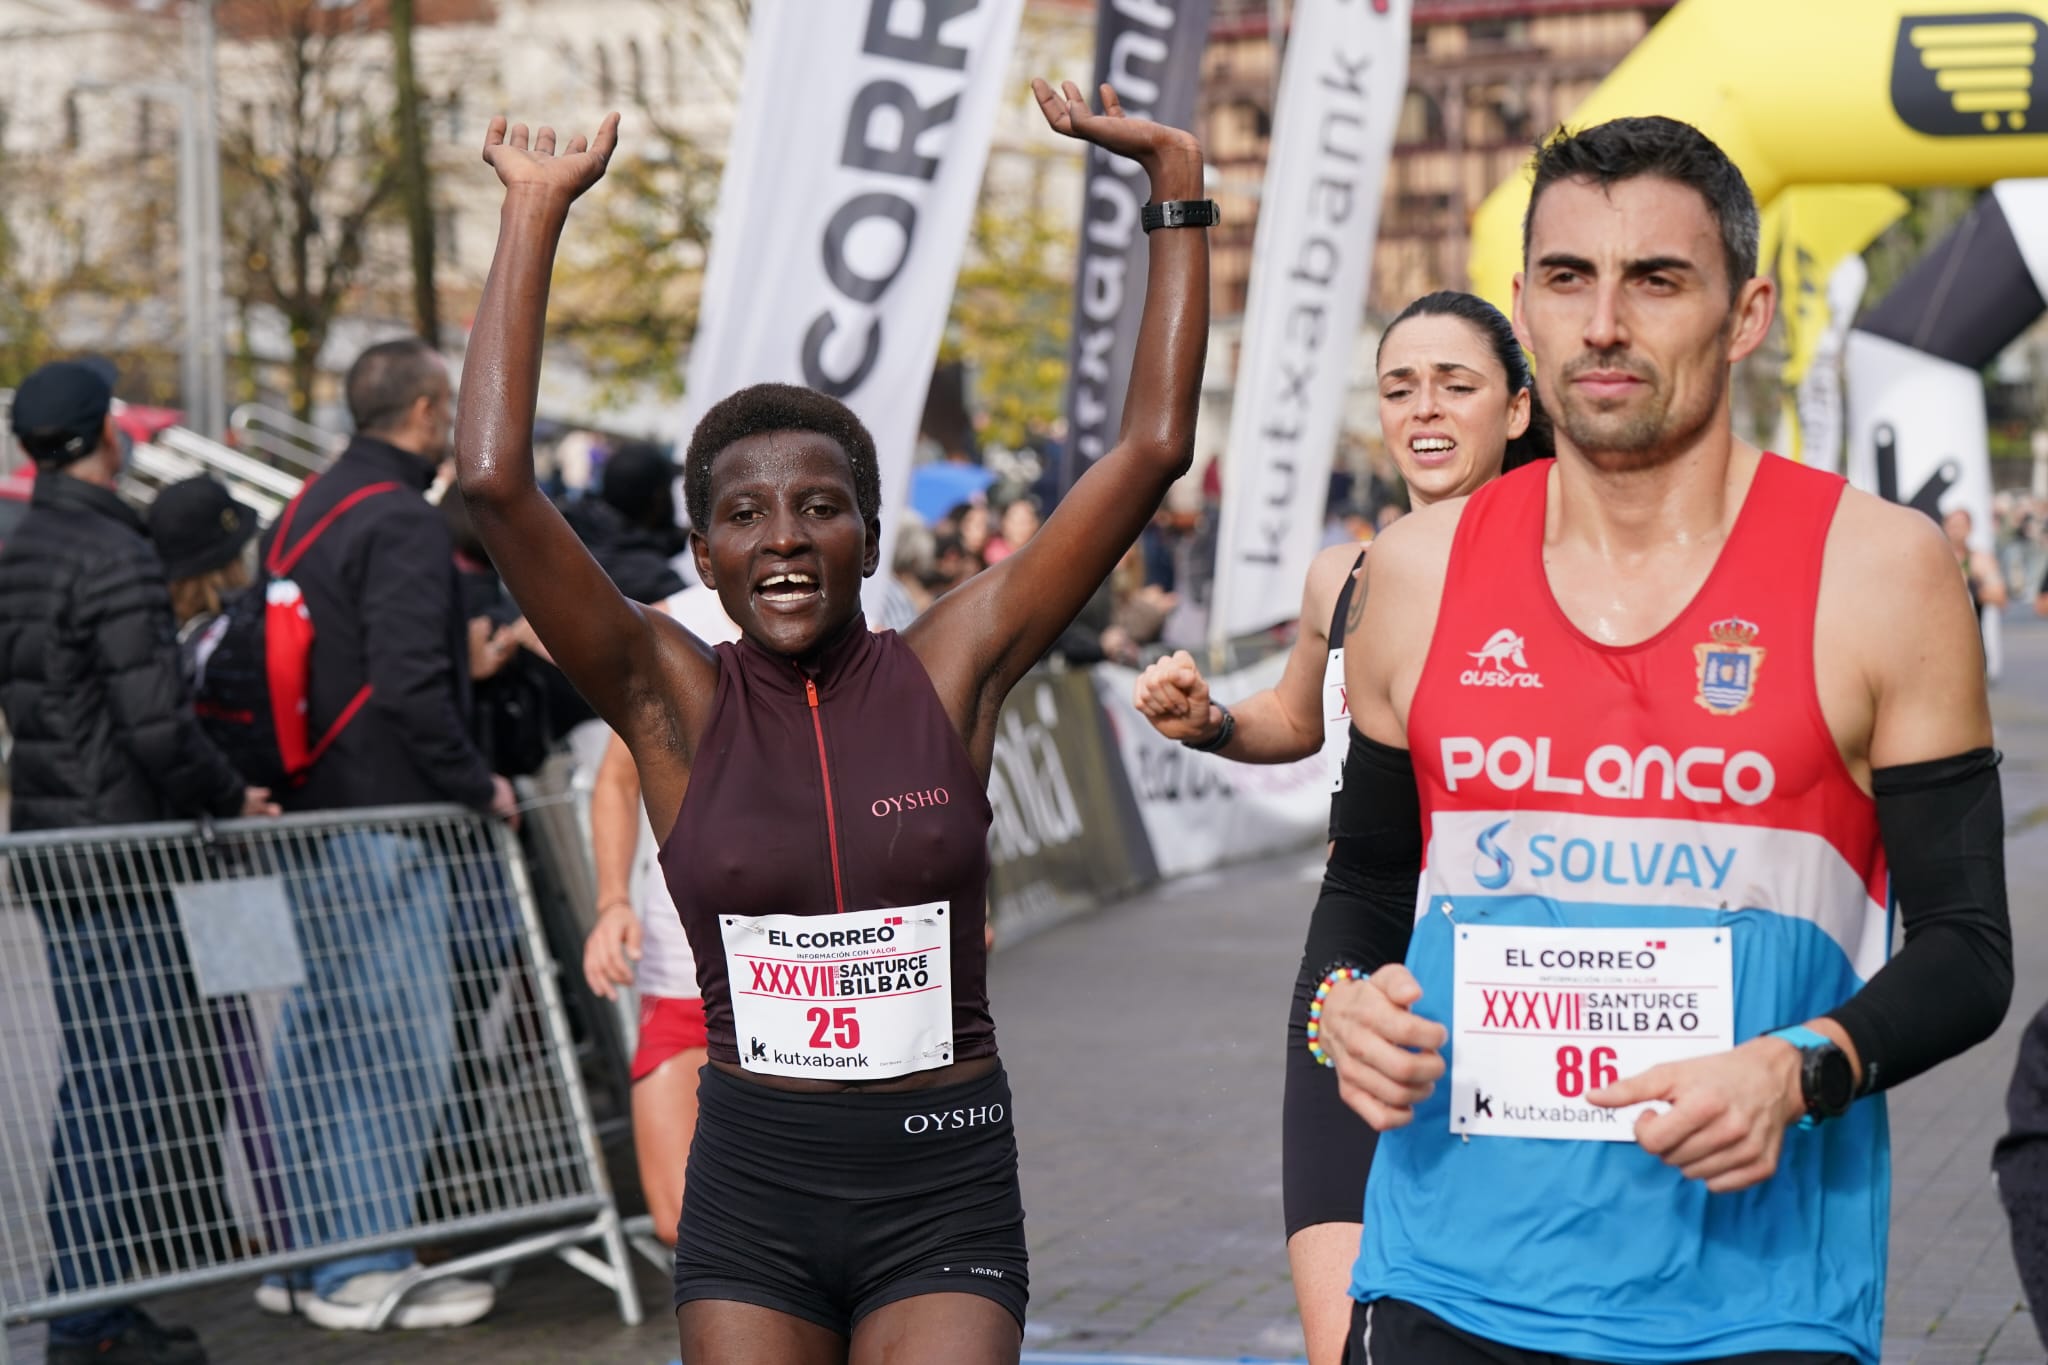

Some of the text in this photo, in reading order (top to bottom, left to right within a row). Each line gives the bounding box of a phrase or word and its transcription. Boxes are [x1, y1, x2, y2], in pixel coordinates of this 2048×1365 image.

[1243, 48, 1373, 569] kutxabank
[871, 787, 949, 817] OYSHO
[1528, 834, 1738, 889] SOLVAY
[768, 925, 895, 949] EL CORREO
[796, 946, 897, 960] INFORMACIÓN CON VALOR
[1505, 949, 1656, 969] EL CORREO
[749, 960, 835, 997] XXXVII
[840, 955, 928, 978] SANTURCE
[840, 970, 929, 997] BILBAO
[1482, 989, 1582, 1030] XXXVII
[1588, 992, 1699, 1010] SANTURCE
[1588, 1011, 1700, 1032] BILBAO
[806, 1006, 861, 1049] 25
[774, 1049, 869, 1067] kutxabank
[1556, 1045, 1619, 1098] 86
[903, 1103, 1005, 1134] OYSHO
[1503, 1101, 1617, 1123] kutxabank
